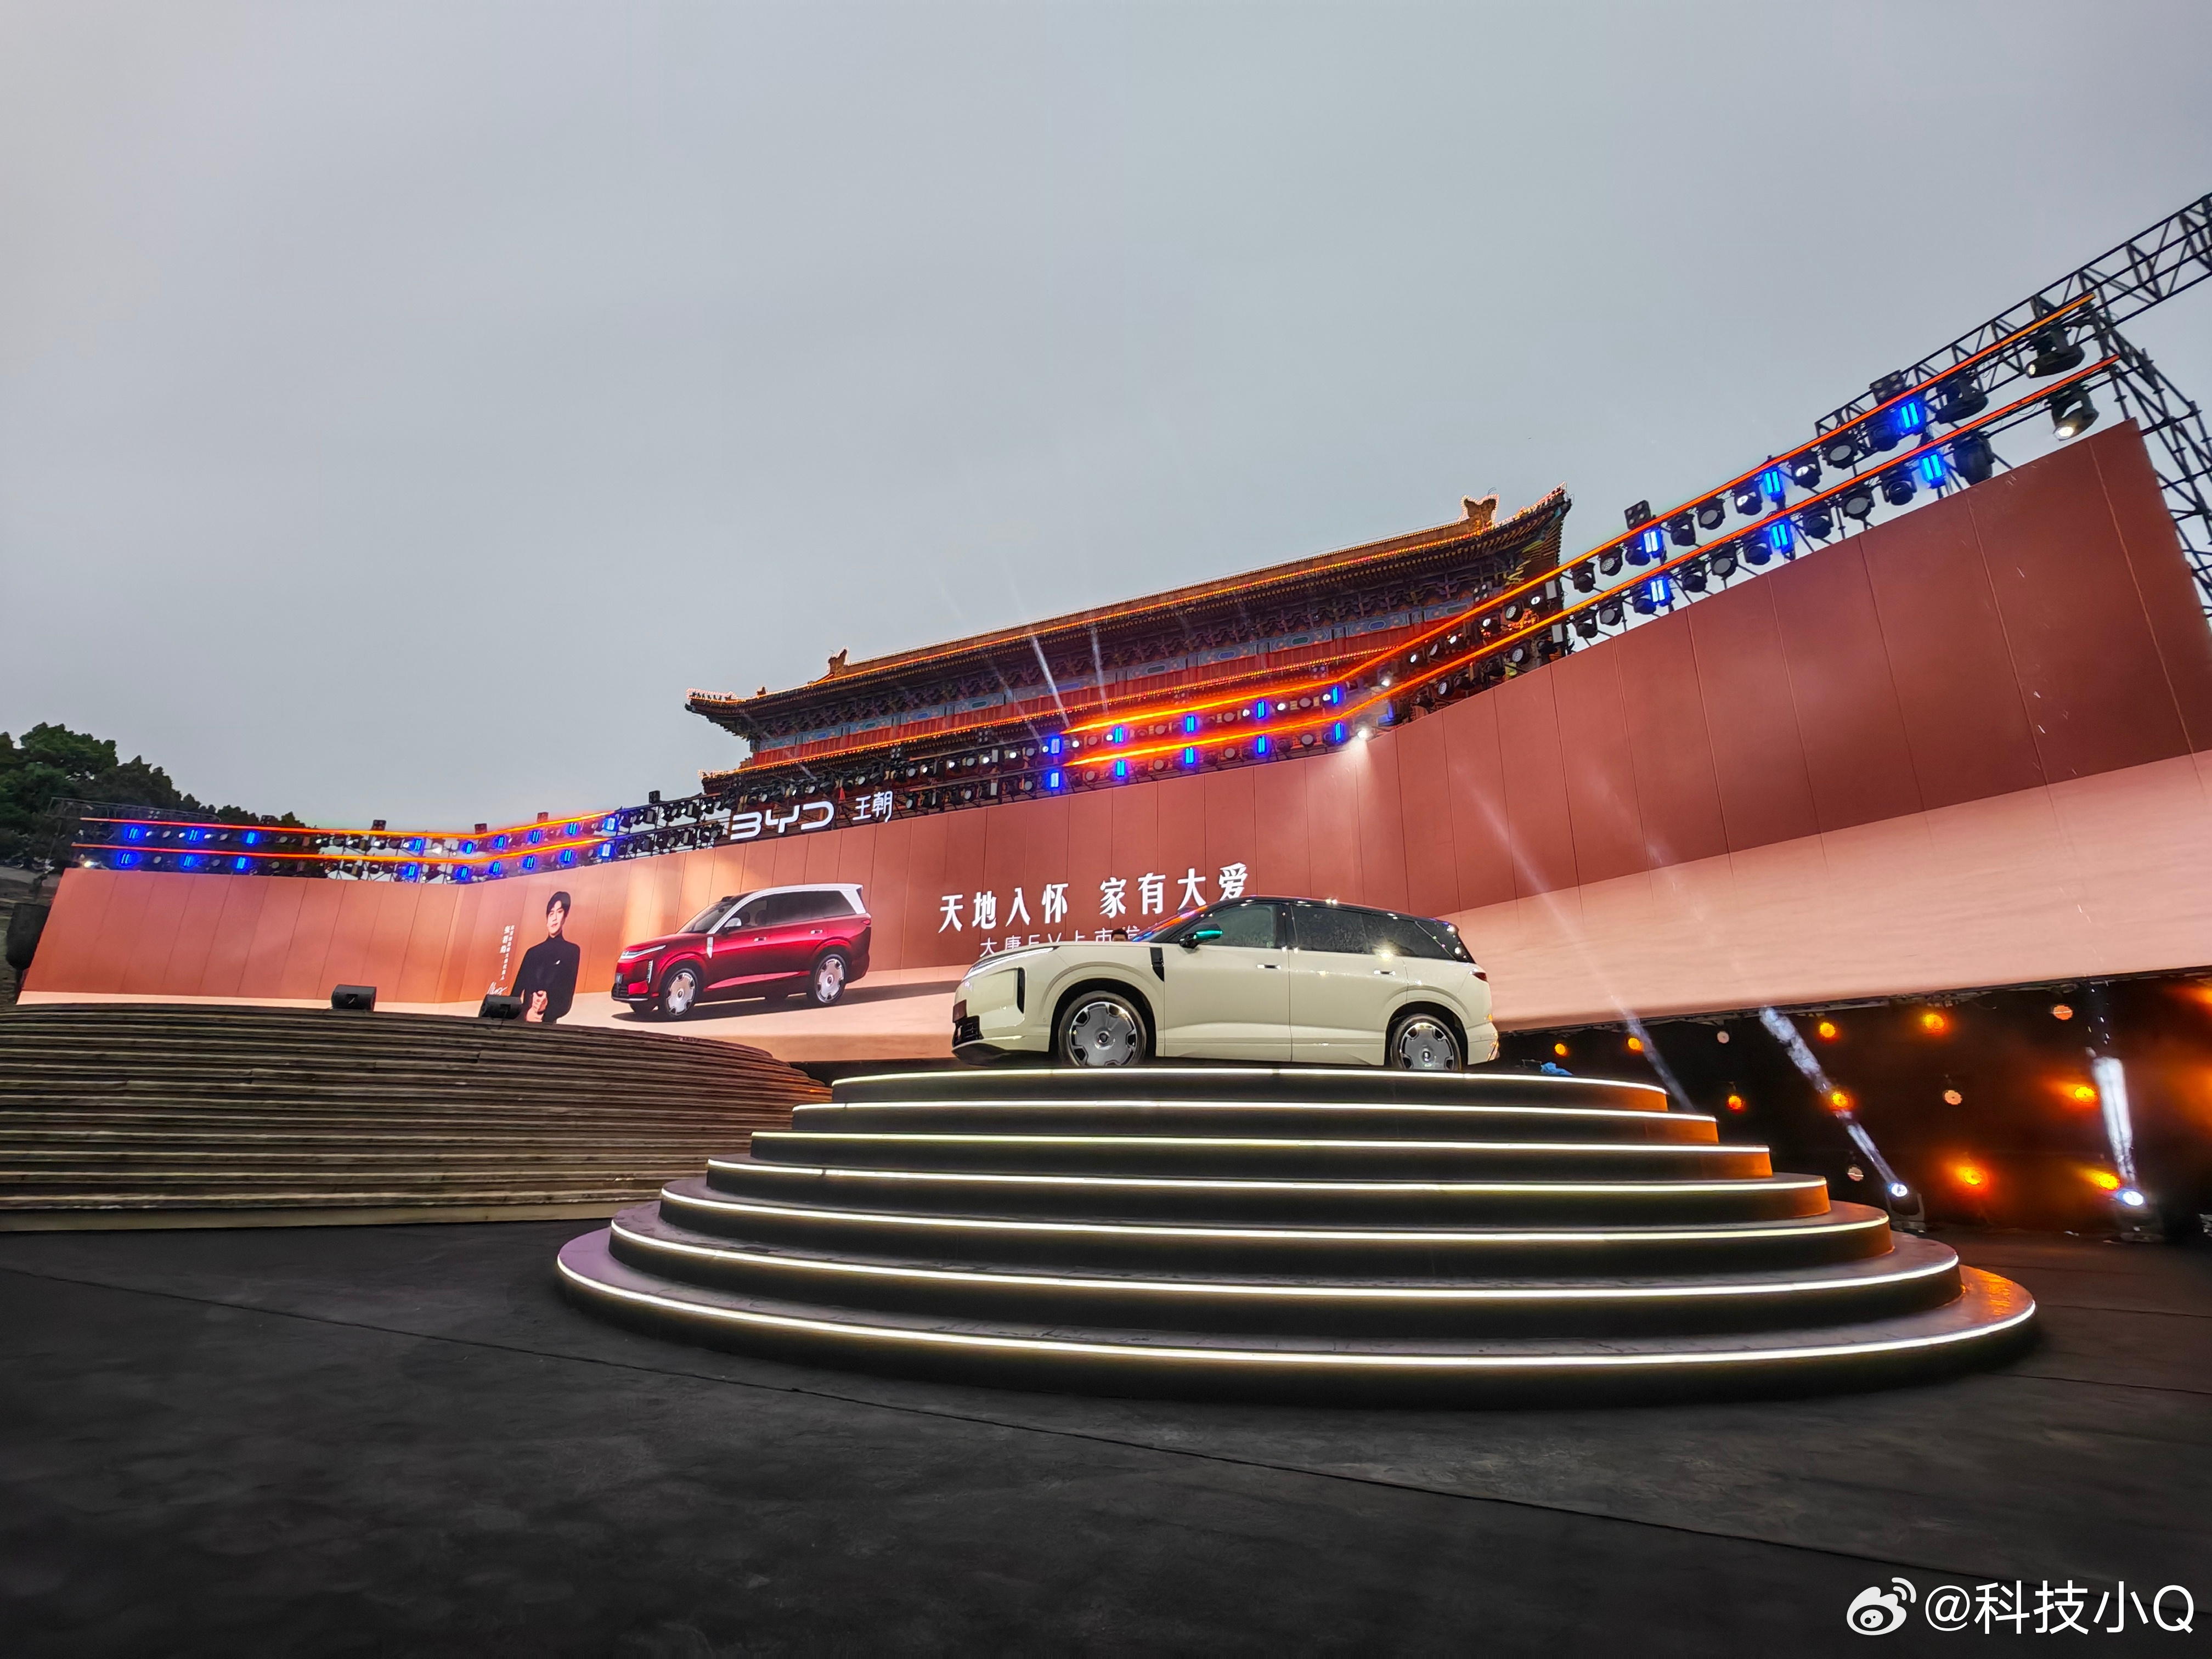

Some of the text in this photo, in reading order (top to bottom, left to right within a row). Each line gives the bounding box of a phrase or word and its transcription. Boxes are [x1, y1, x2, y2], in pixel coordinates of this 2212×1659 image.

[730, 791, 893, 840] BYD 王朝
[938, 862, 1248, 933] 天地入怀 家有大爱
